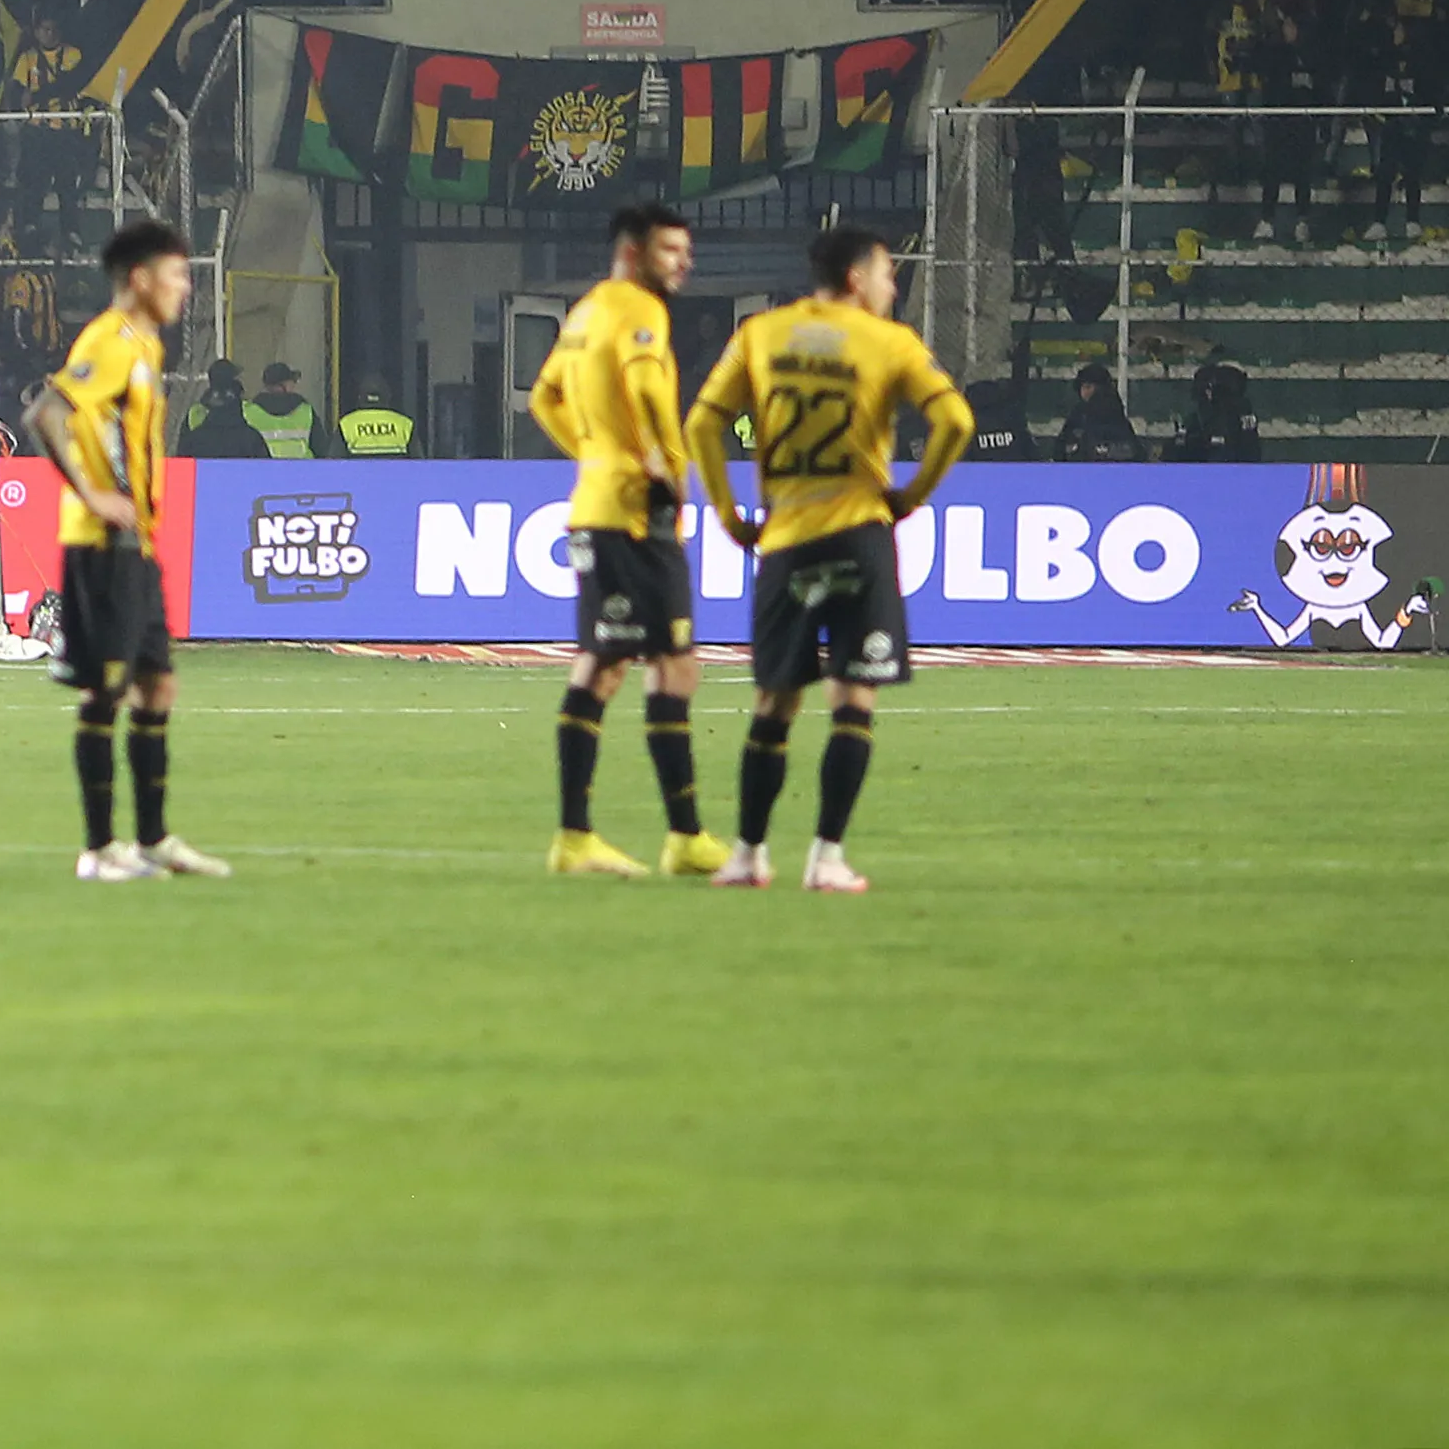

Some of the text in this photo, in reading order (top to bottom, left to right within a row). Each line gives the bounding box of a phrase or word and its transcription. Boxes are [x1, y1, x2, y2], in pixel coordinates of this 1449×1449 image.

[557, 169, 595, 192] 1990
[356, 423, 398, 438] POLICIA
[764, 386, 854, 477] 22
[977, 432, 1014, 449] UTOP
[251, 545, 368, 578] FULBO
[415, 501, 745, 599] NOI
